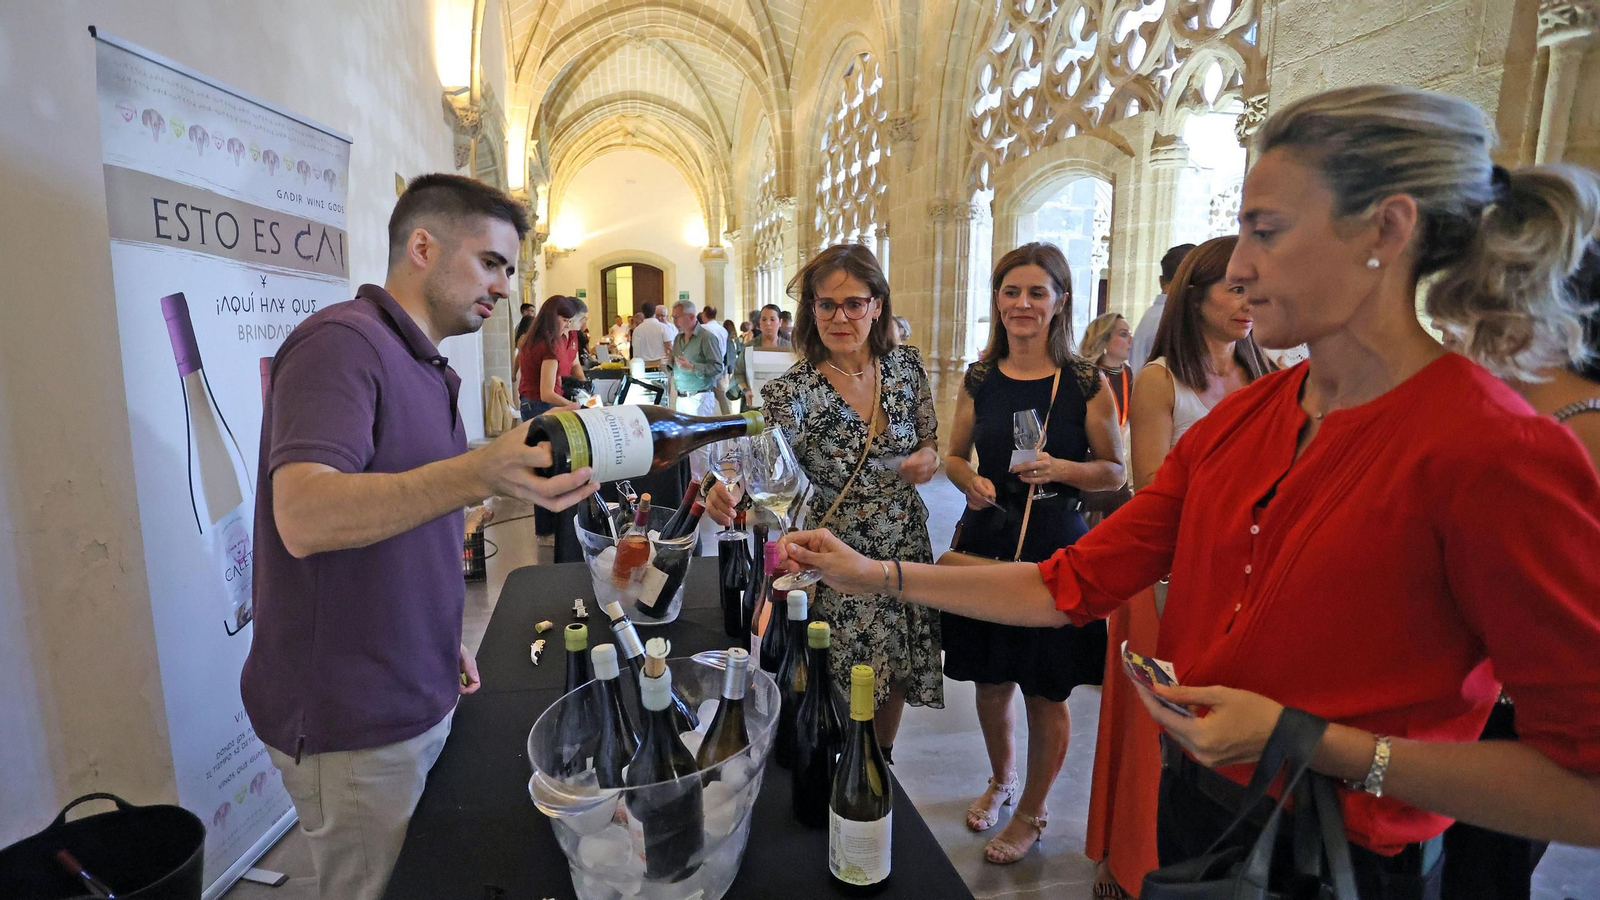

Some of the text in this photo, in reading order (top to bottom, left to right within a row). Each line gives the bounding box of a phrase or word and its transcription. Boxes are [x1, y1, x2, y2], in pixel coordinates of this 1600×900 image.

[276, 189, 303, 205] GADIR
[327, 202, 345, 214] GODS
[152, 197, 240, 250] ESTO
[253, 217, 281, 255] ES
[216, 291, 318, 316] ¡AQUÍ HAY QUE
[237, 324, 296, 343] BRINDAR
